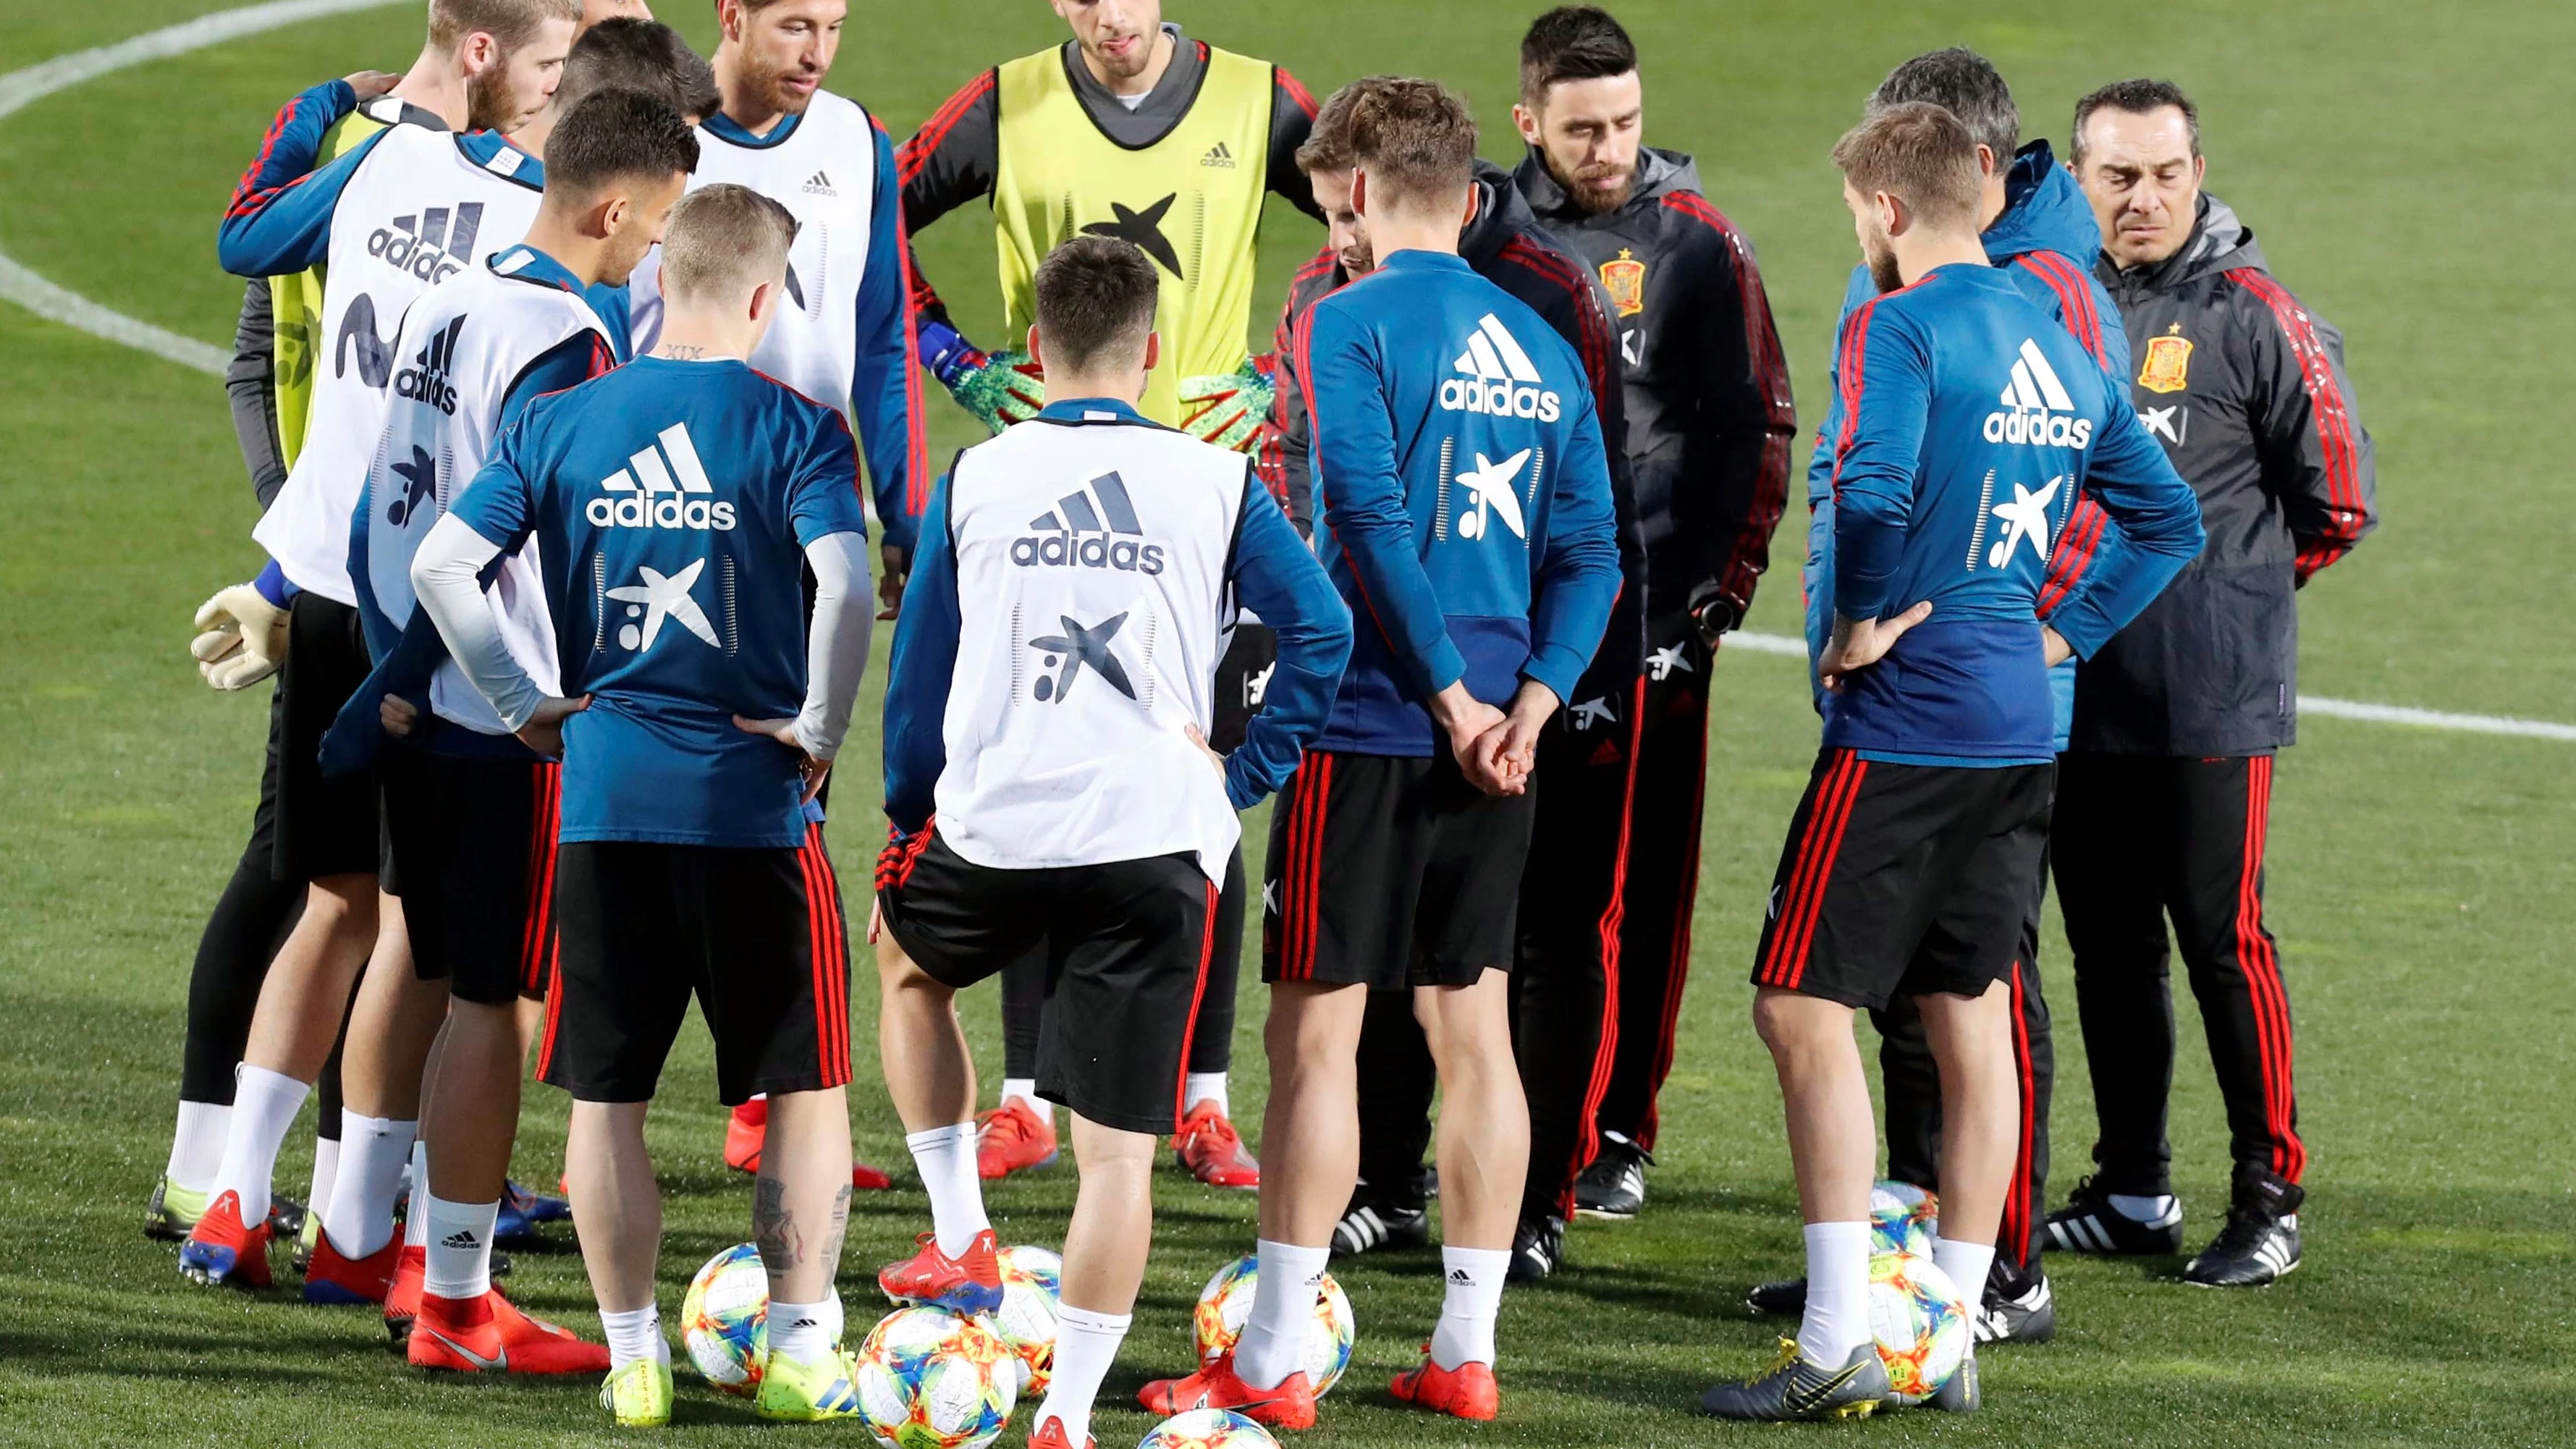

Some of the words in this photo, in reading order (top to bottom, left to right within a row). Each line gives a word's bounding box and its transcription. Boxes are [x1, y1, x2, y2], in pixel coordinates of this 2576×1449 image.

[1200, 157, 1236, 169] adidas
[802, 185, 837, 197] adidas
[368, 228, 461, 285] adida
[665, 344, 706, 360] XIX
[394, 366, 457, 417] adidas
[1439, 373, 1561, 423] adidas
[1983, 405, 2093, 450] adidas
[586, 489, 737, 531] adidas
[1010, 529, 1165, 575] adidas
[442, 1240, 481, 1249] adidas
